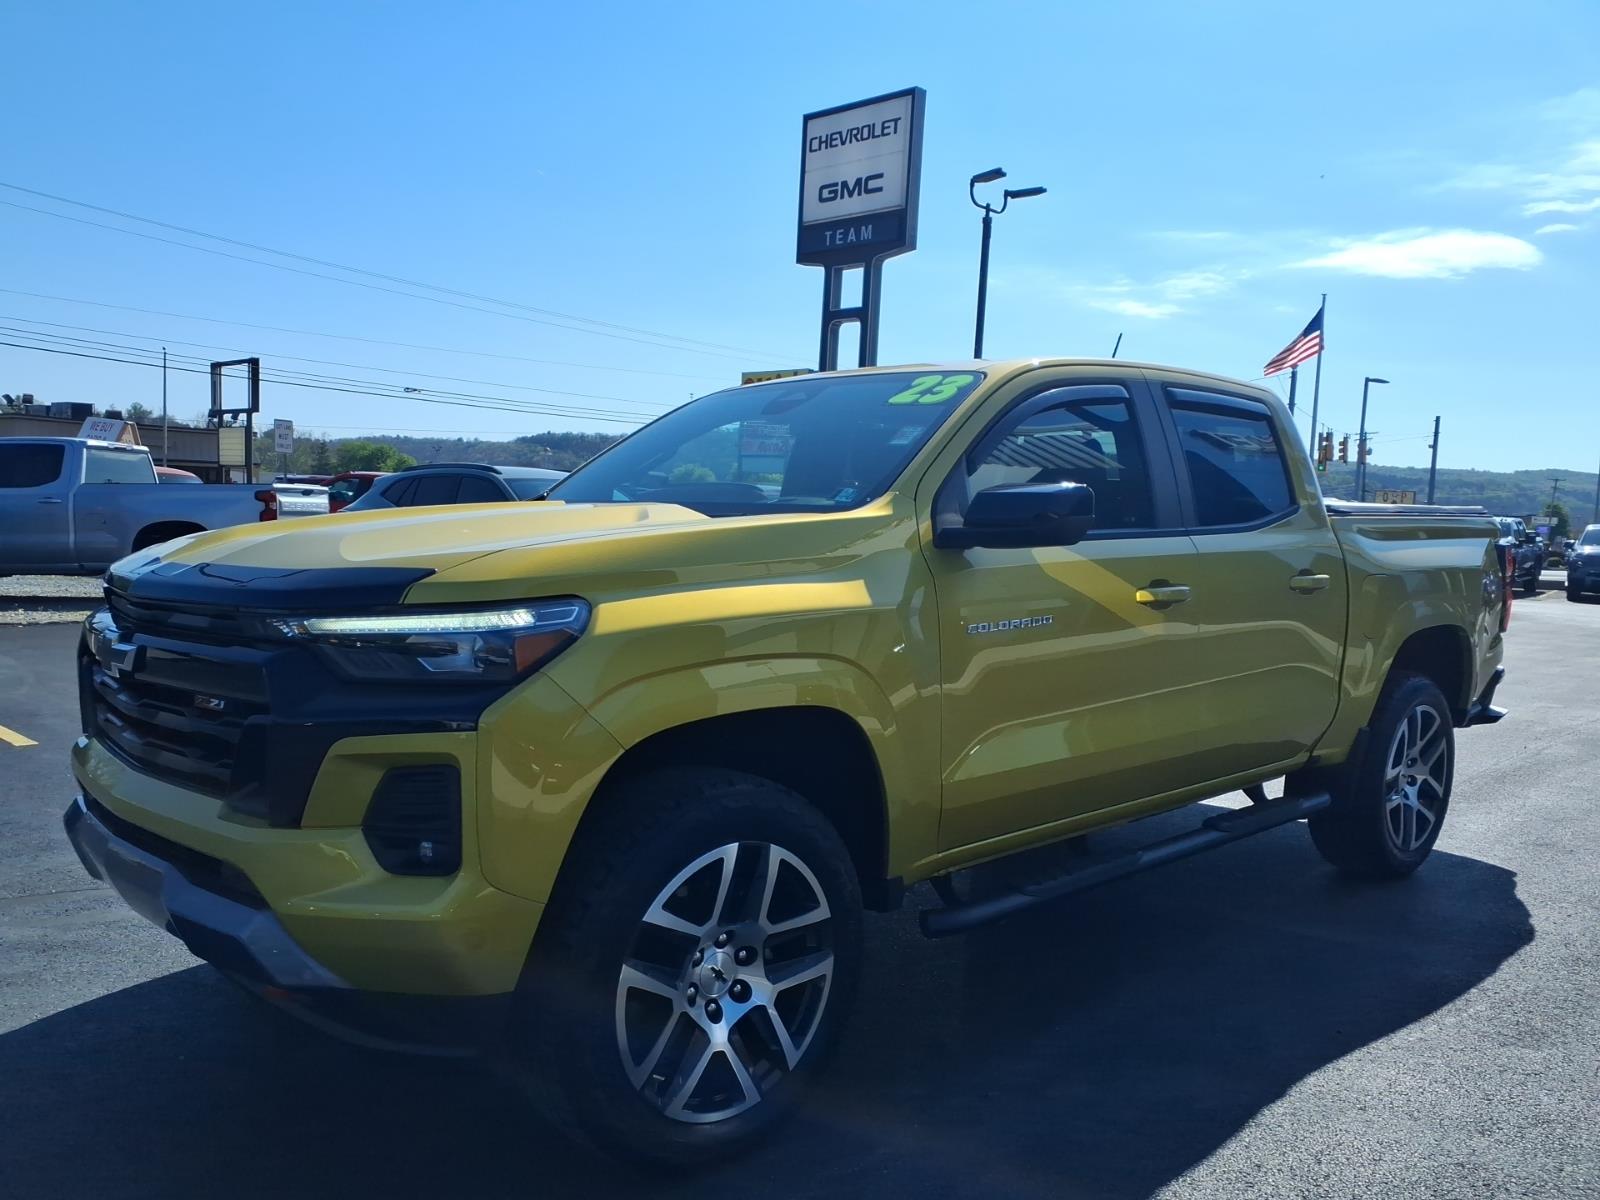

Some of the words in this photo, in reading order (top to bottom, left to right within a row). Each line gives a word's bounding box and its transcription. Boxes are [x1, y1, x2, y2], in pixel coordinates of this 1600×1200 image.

[808, 117, 902, 153] CHEVROLET
[818, 172, 885, 203] GMC
[824, 224, 873, 246] TEAM
[887, 374, 975, 405] 23
[967, 615, 1054, 634] COLORADO
